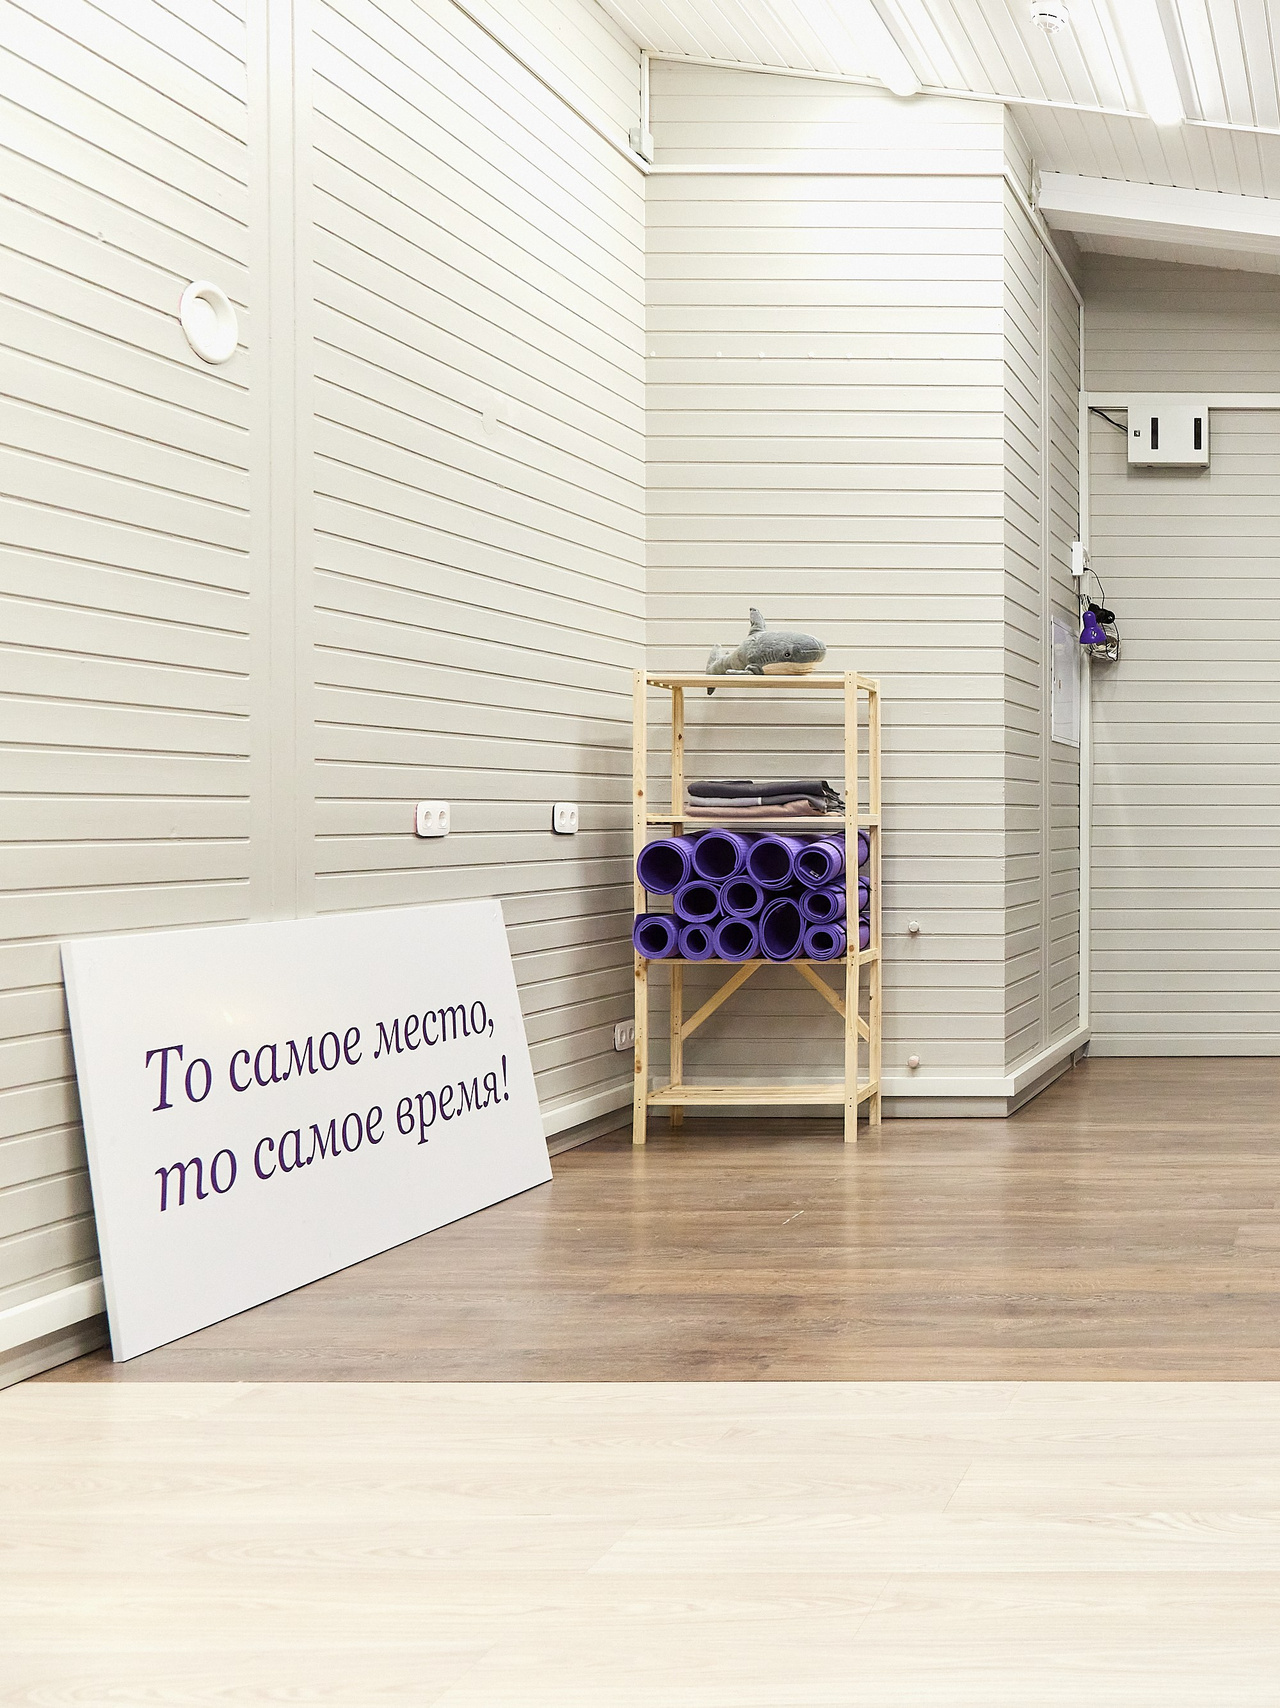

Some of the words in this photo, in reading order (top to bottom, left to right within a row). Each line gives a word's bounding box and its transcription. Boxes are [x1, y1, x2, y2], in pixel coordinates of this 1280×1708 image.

[145, 1044, 212, 1112] То
[229, 1026, 363, 1093] самое
[373, 1000, 494, 1060] место,
[154, 1148, 237, 1212] то
[253, 1105, 385, 1180] самое
[396, 1054, 510, 1146] время!
